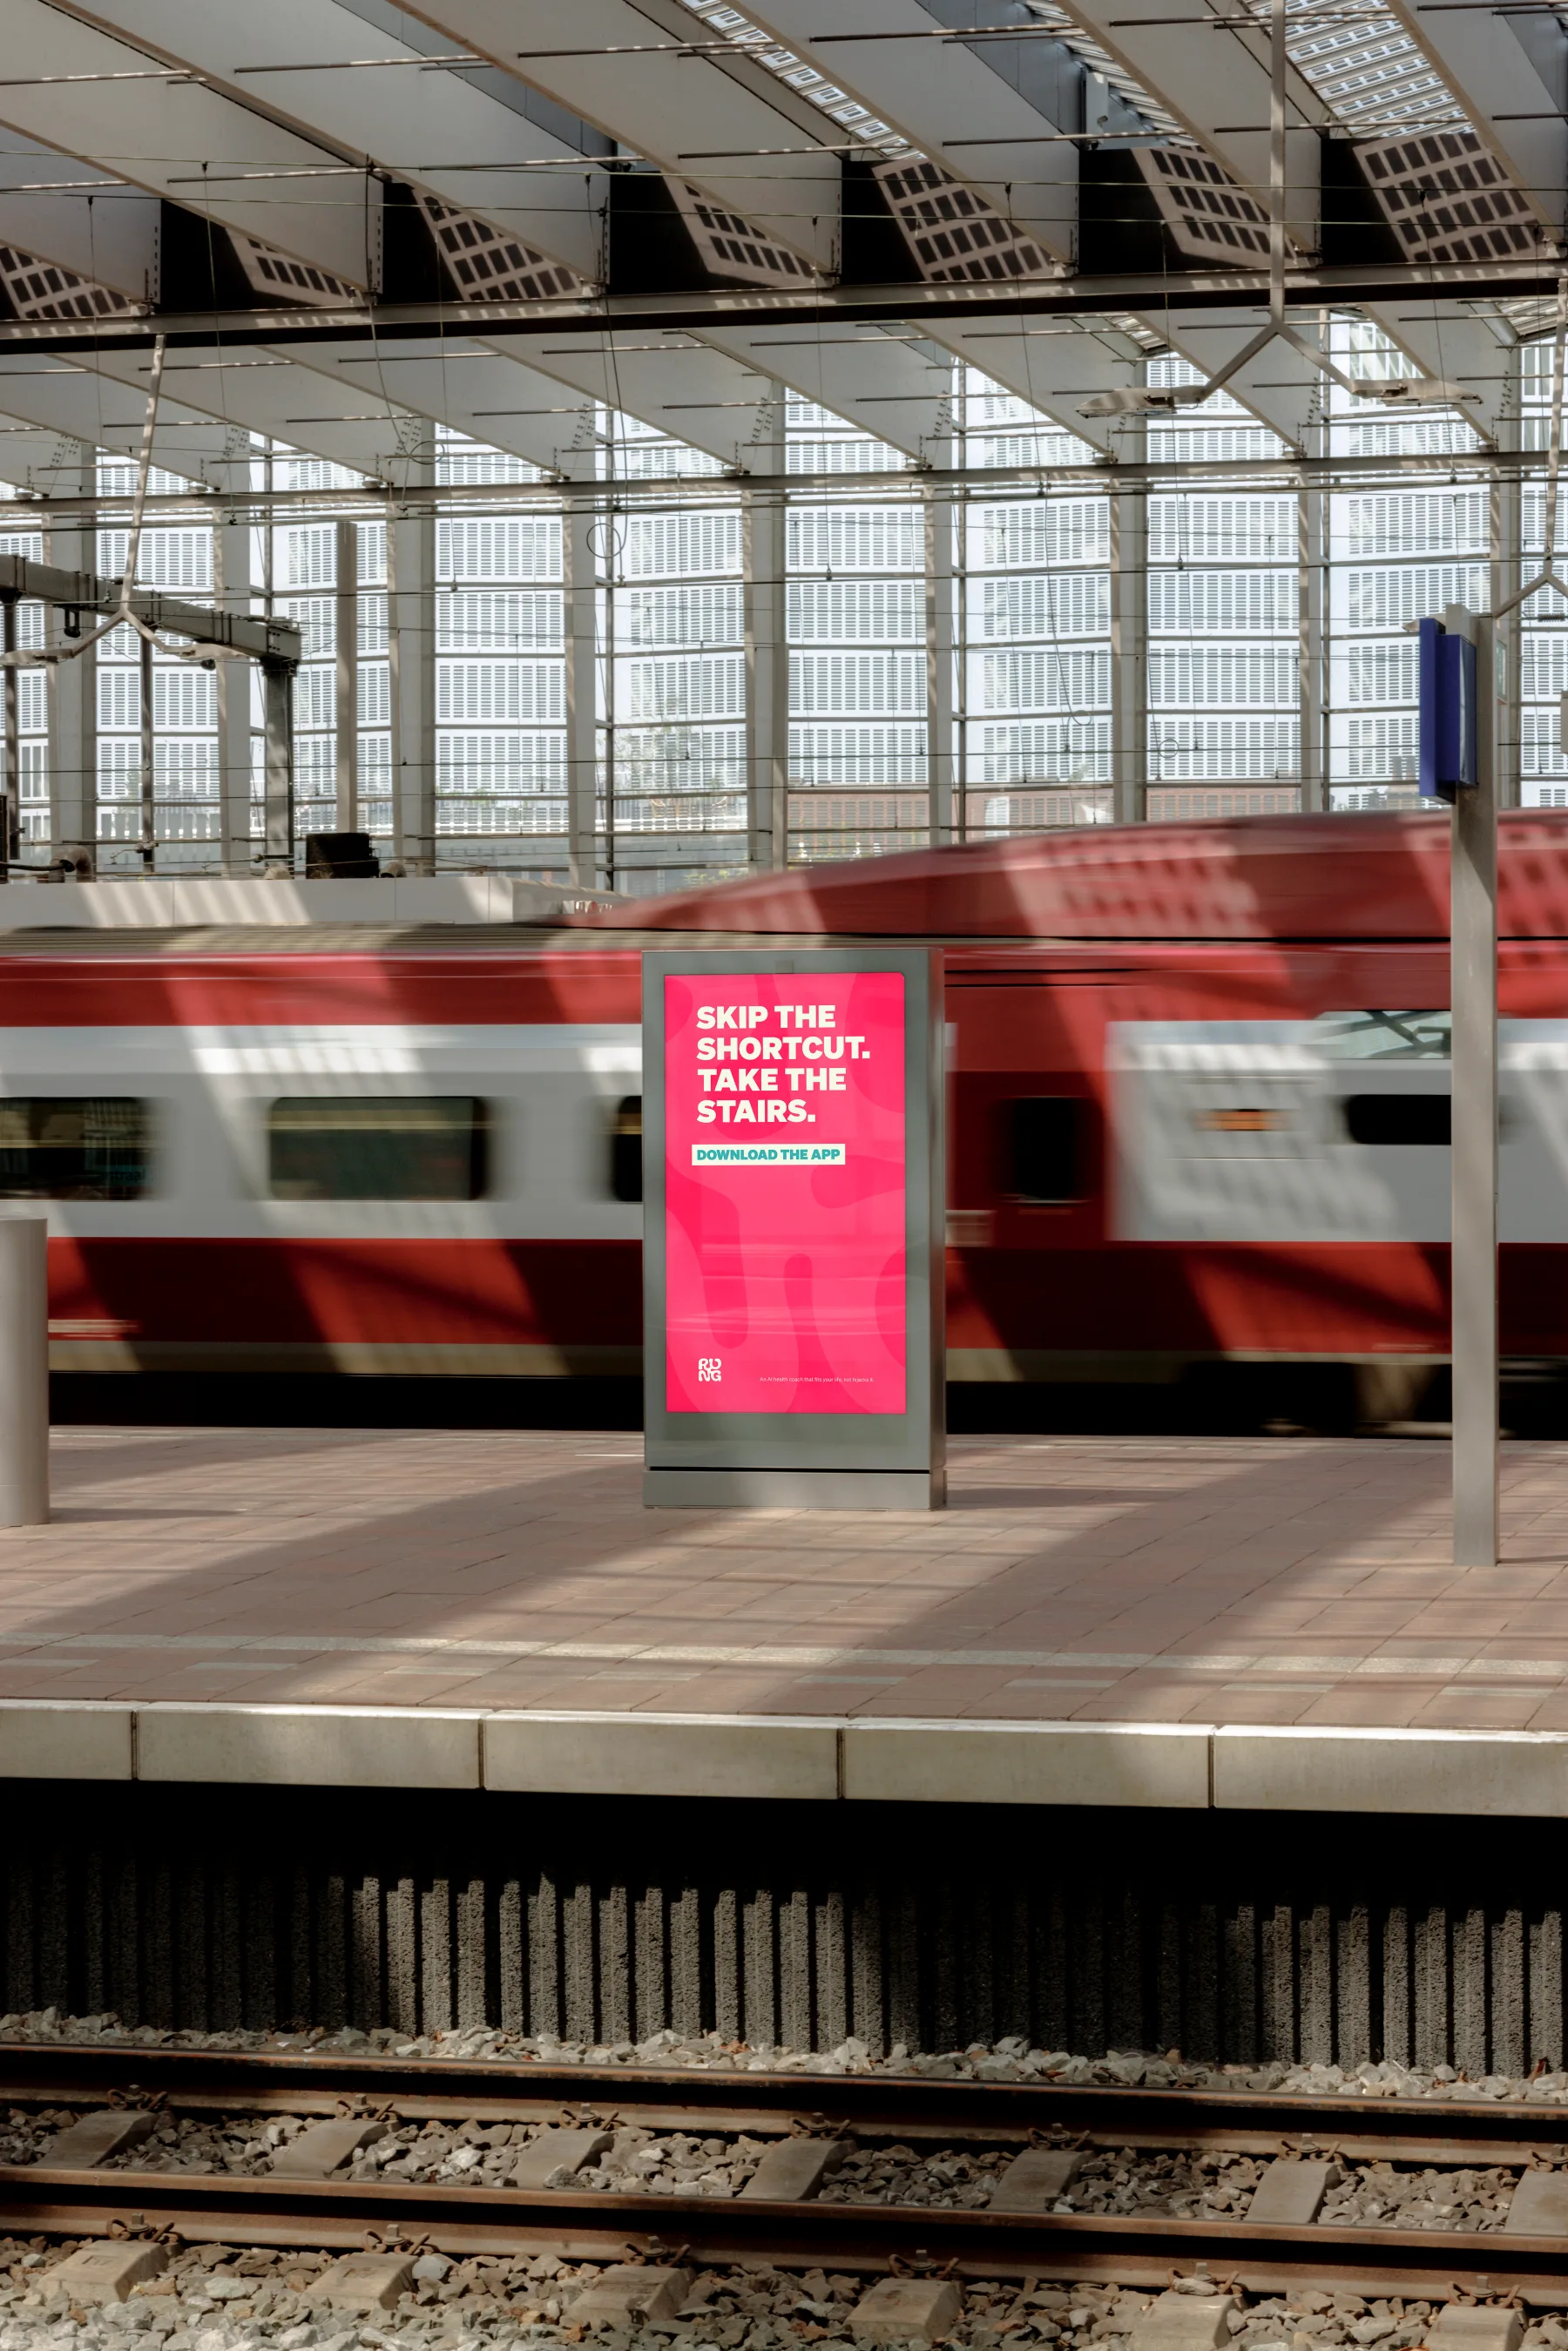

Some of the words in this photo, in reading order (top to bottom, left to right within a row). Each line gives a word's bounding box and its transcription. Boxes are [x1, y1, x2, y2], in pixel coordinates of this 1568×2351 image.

[696, 1005, 768, 1030] SKIP
[774, 1004, 836, 1029] THE
[696, 1036, 870, 1061] SHORTCUT.
[697, 1068, 779, 1092] TAKE
[785, 1067, 847, 1091] THE
[696, 1098, 816, 1124] STAIRS.
[696, 1149, 778, 1161] DOWNLOAD
[781, 1149, 808, 1160] THE
[810, 1148, 841, 1160] APP
